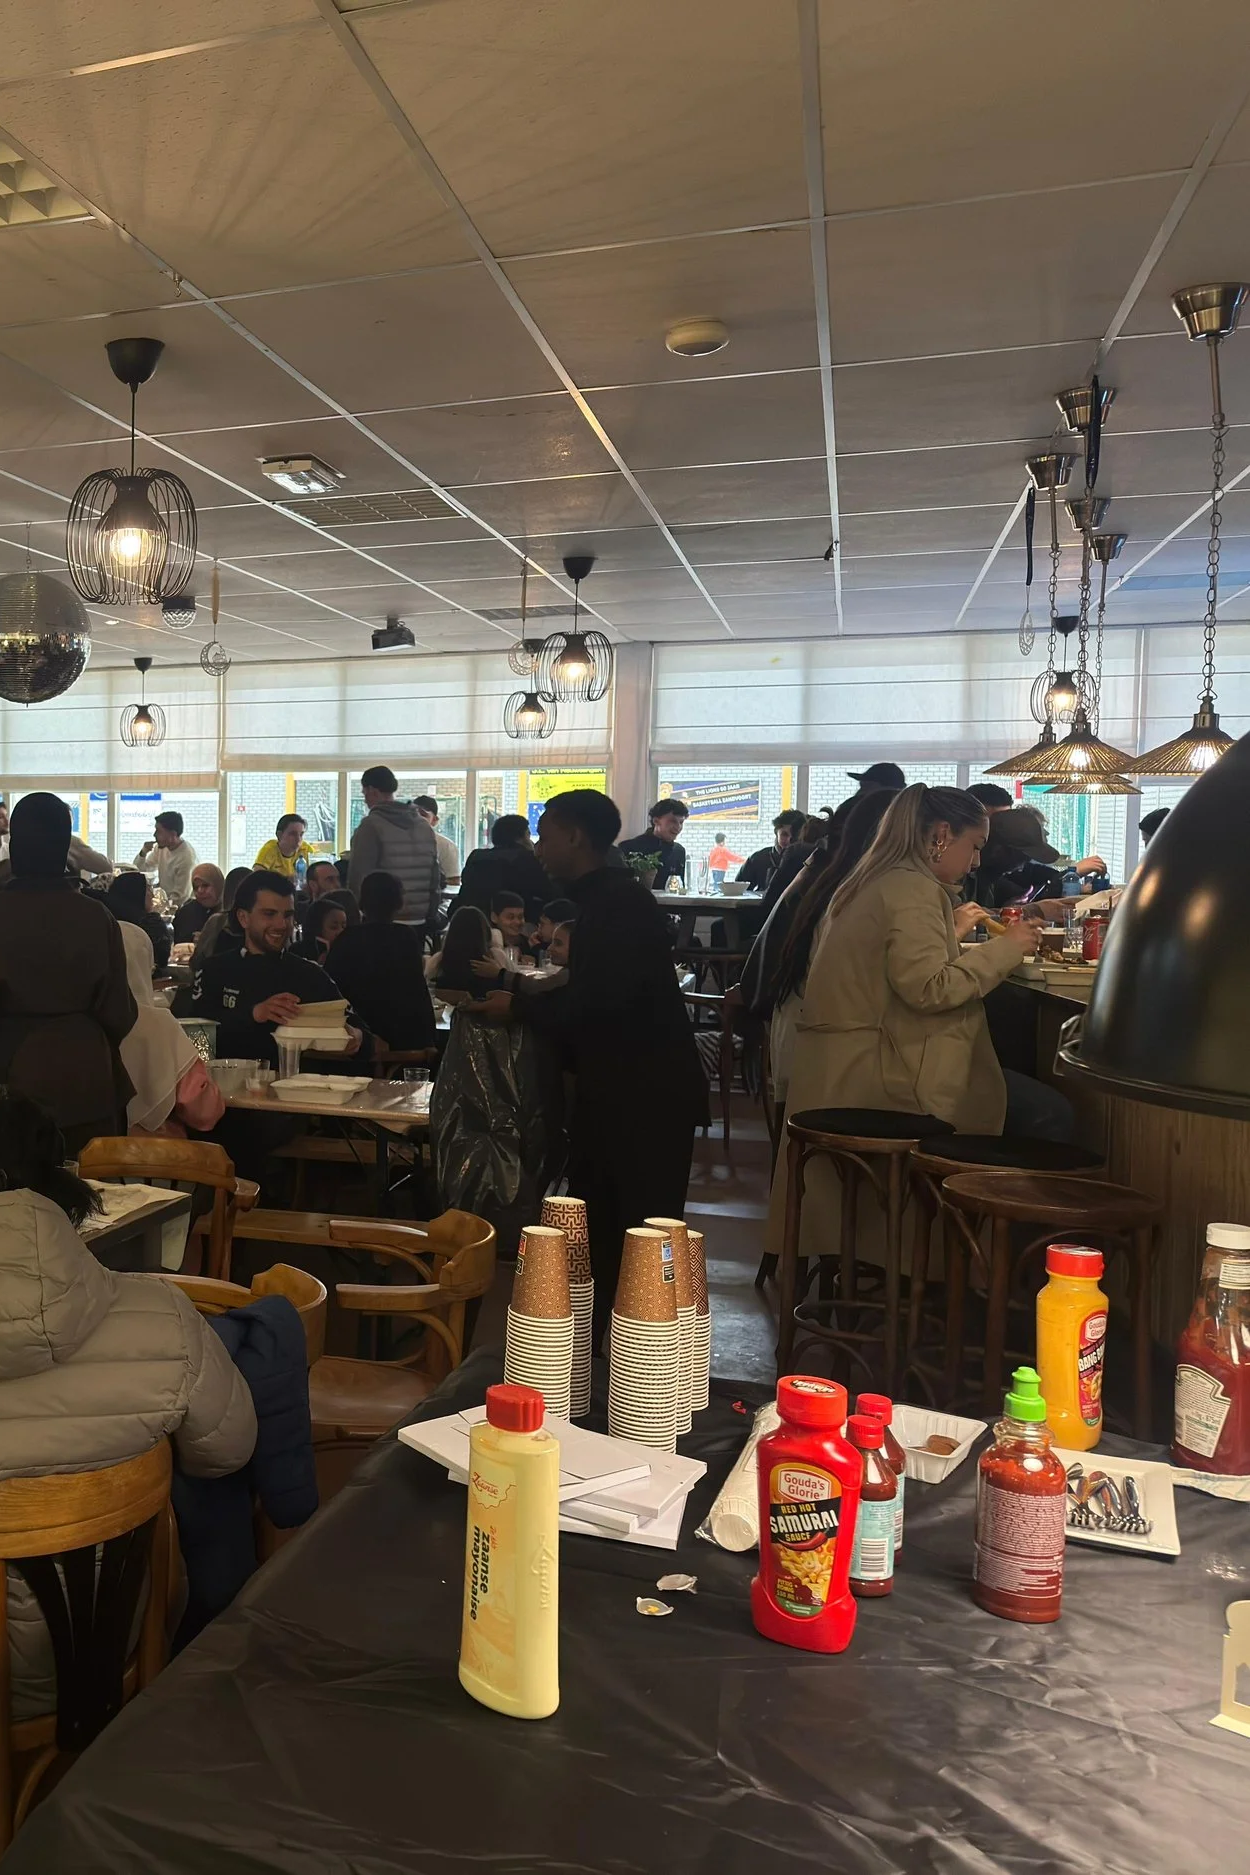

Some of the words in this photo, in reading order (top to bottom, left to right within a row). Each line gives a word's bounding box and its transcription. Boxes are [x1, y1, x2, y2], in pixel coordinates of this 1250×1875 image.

[1078, 1352, 1097, 1371] BANG
[784, 1473, 825, 1490] Gouda's
[788, 1485, 820, 1500] Glorie
[781, 1505, 797, 1514] RED
[799, 1503, 816, 1512] HOT
[770, 1509, 840, 1534] SAMURAI
[480, 1531, 490, 1594] zaanse
[470, 1525, 481, 1621] mayonaise
